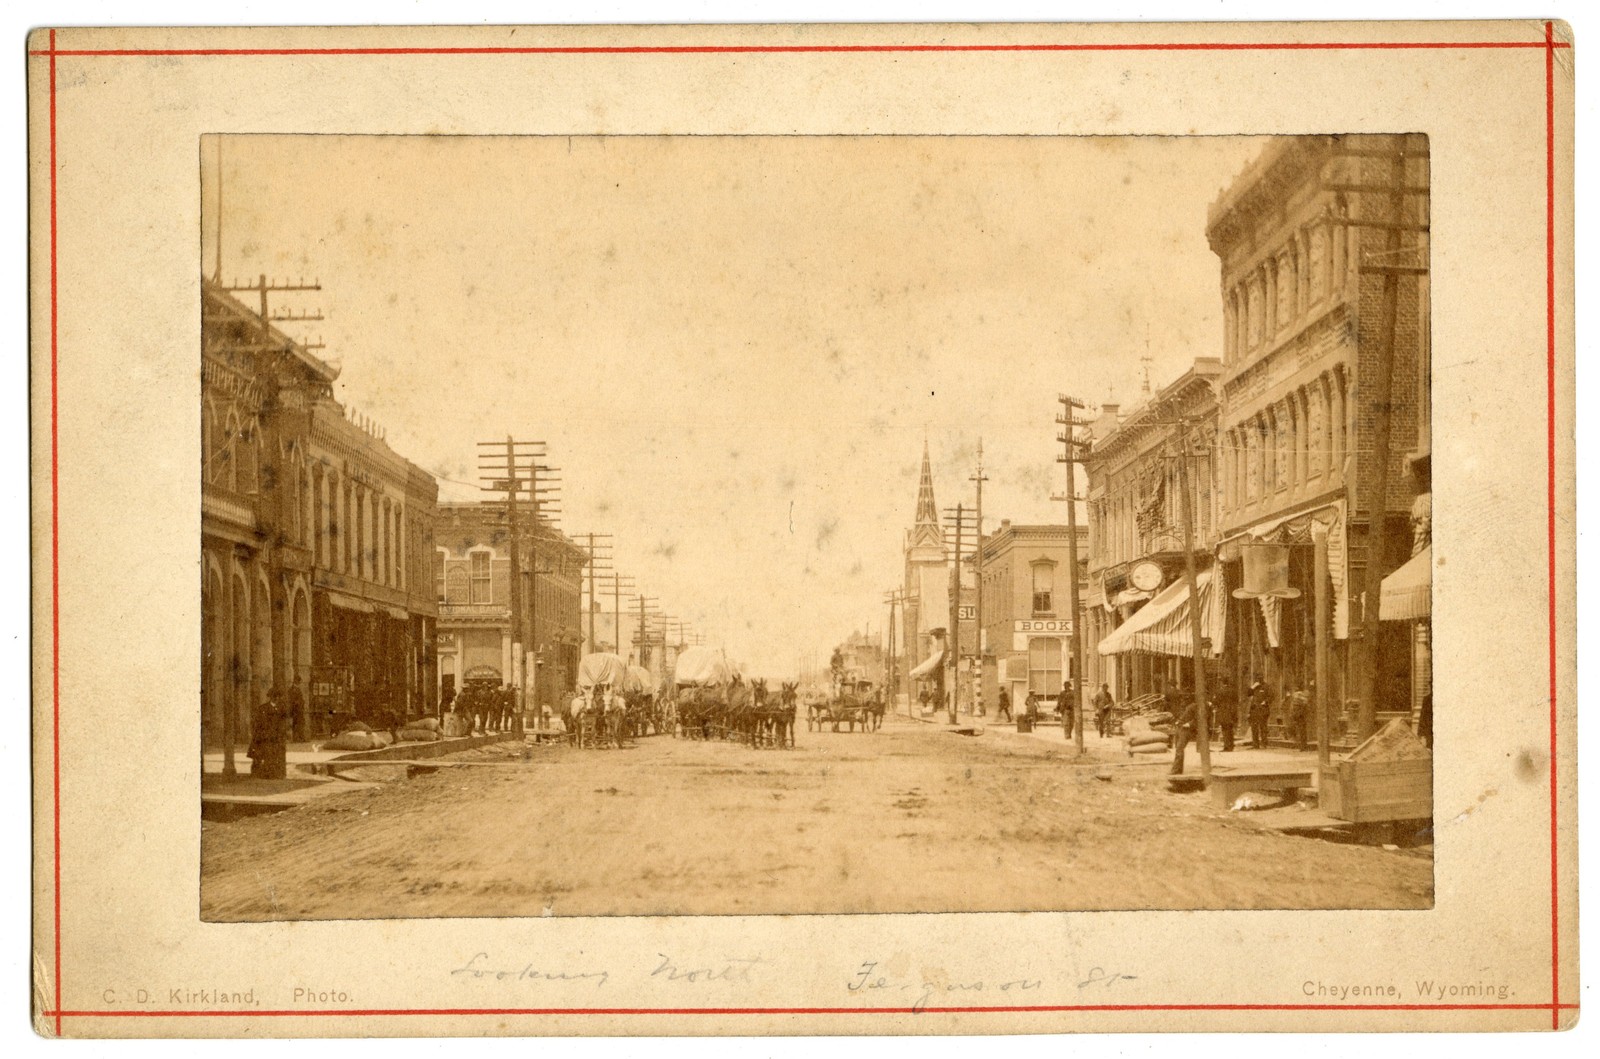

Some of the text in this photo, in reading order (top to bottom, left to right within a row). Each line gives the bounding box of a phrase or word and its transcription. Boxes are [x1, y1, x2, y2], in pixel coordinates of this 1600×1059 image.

[1021, 621, 1071, 631] BOOK
[450, 951, 609, 987] Looking
[847, 960, 1043, 1015] Ferguson
[1302, 980, 1516, 1000] Cheyenne, Wyoming.
[102, 986, 354, 1006] C. D. Kirkland, Photo.
